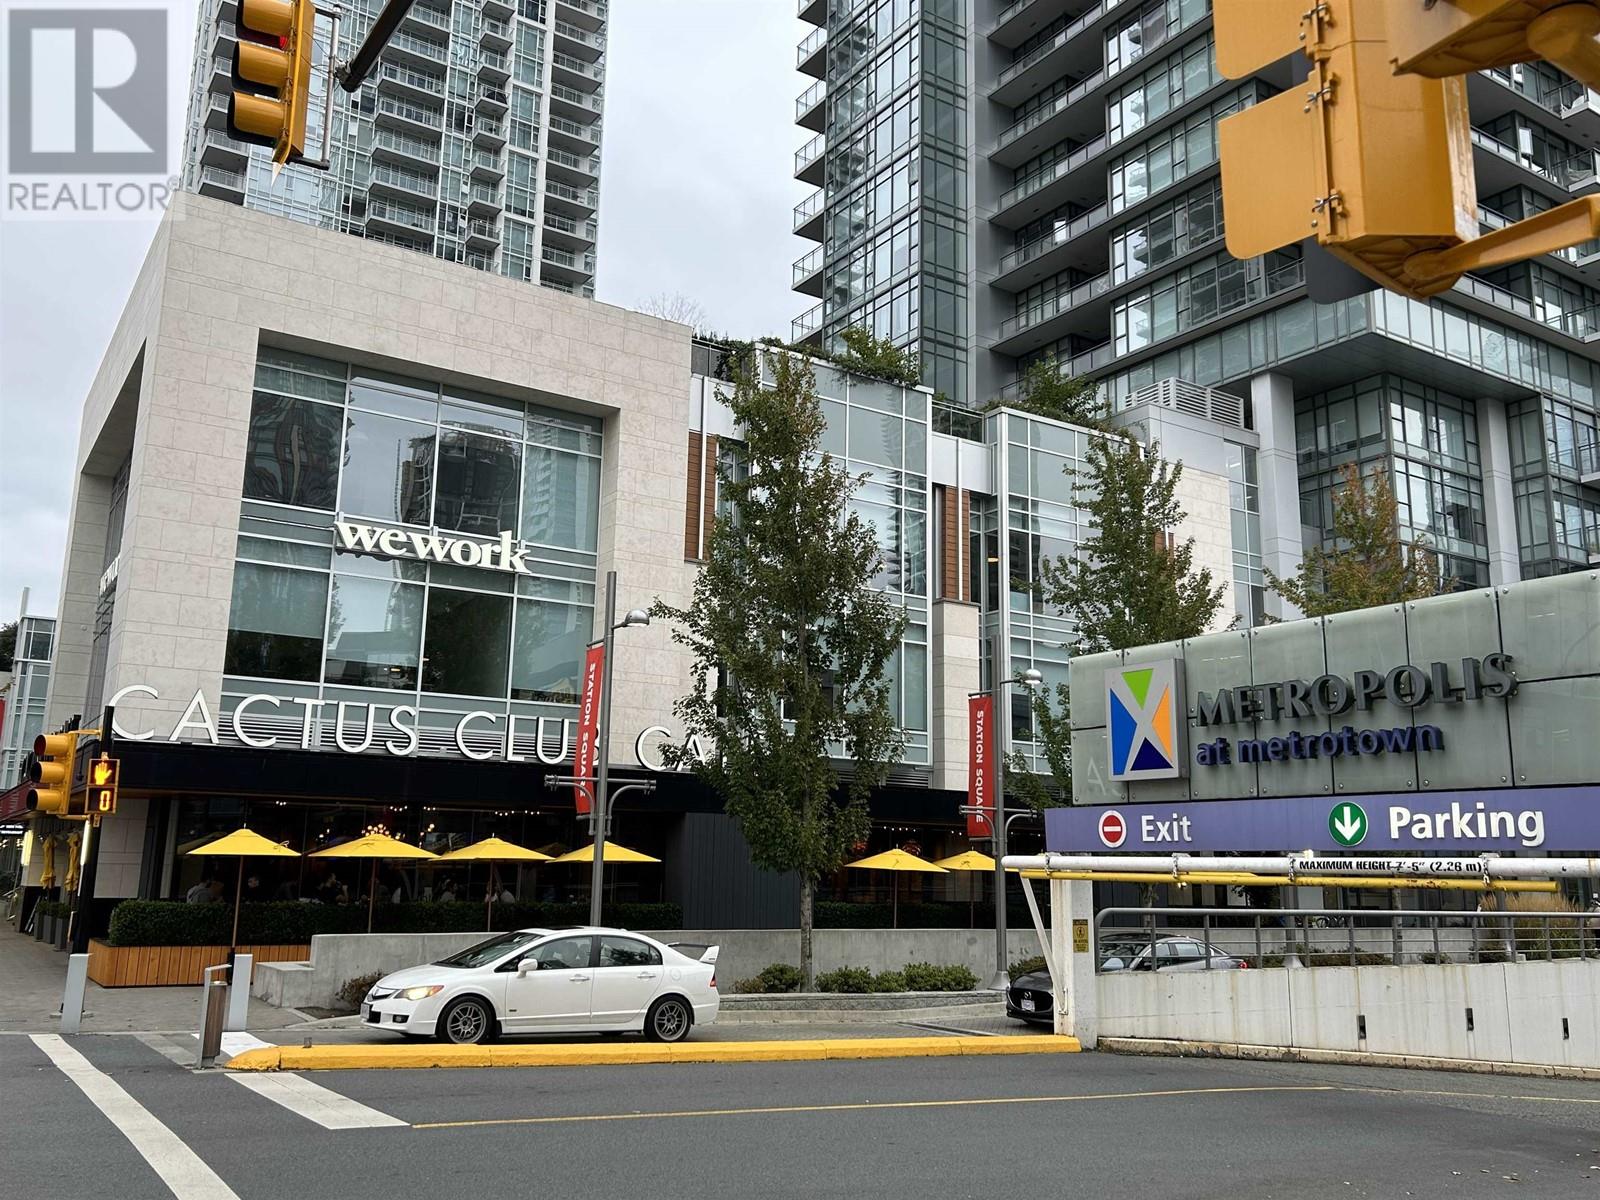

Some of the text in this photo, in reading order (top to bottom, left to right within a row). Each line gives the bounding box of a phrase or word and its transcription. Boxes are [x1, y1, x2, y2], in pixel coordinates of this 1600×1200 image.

[334, 521, 532, 573] wework
[584, 662, 596, 726] STATION
[1196, 652, 1519, 727] METROPOLIS
[108, 684, 417, 756] CACTUS
[635, 725, 709, 772] CA
[976, 710, 984, 764] STATION
[1195, 724, 1445, 766] at metrotown
[1141, 813, 1192, 842] Exit
[1389, 802, 1545, 847] Parking
[1299, 861, 1353, 870] MAXIMUM
[1356, 861, 1391, 871] HEIGHT
